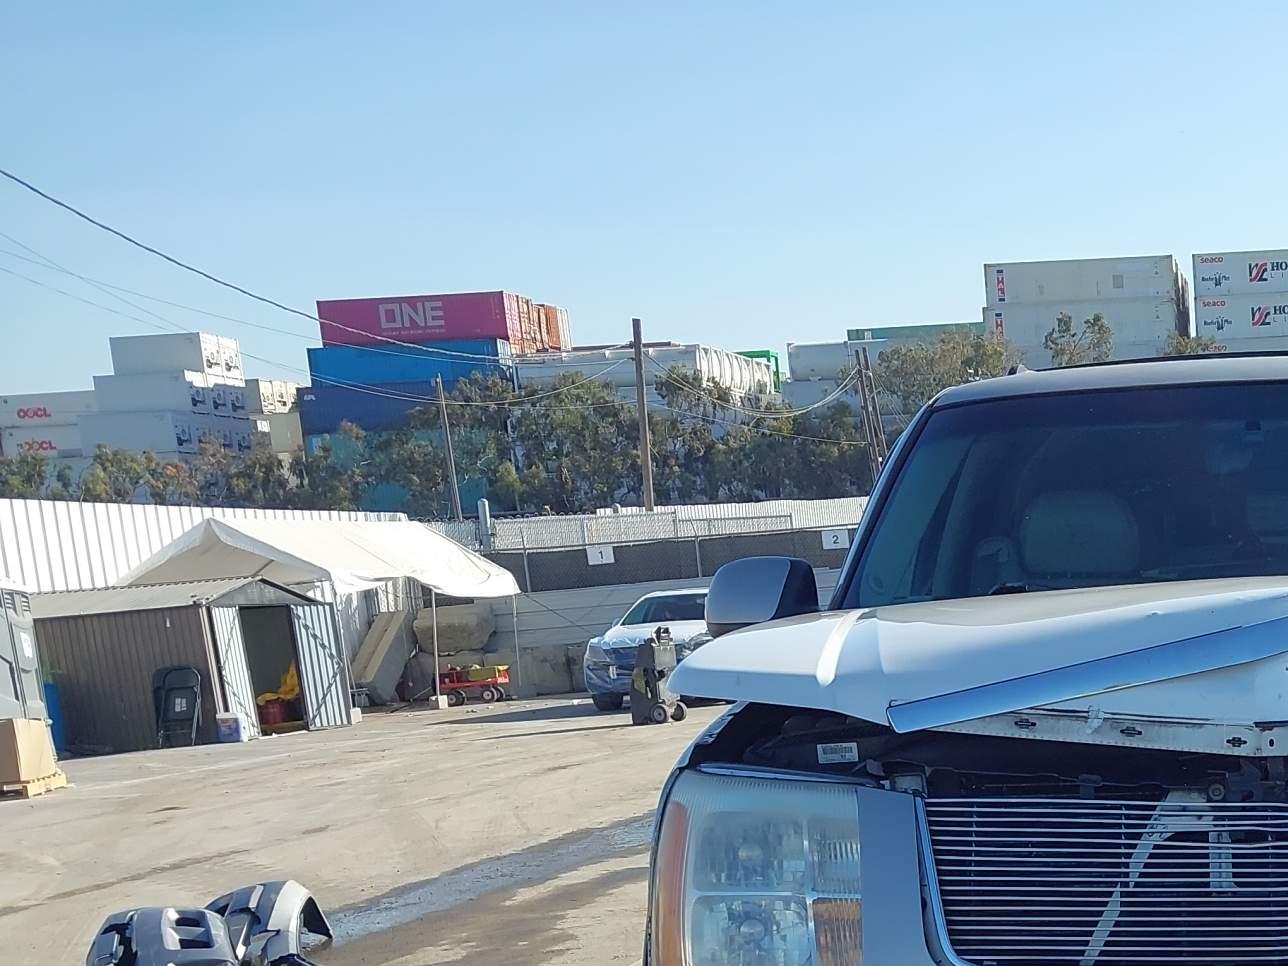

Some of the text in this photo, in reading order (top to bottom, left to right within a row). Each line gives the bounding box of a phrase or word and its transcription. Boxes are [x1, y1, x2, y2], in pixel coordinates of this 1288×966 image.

[1200, 256, 1224, 264] seaco
[1202, 299, 1226, 307] seaco
[379, 301, 445, 328] ONE
[17, 408, 52, 419] OOCL
[832, 534, 840, 545] 2
[598, 550, 604, 560] 1
